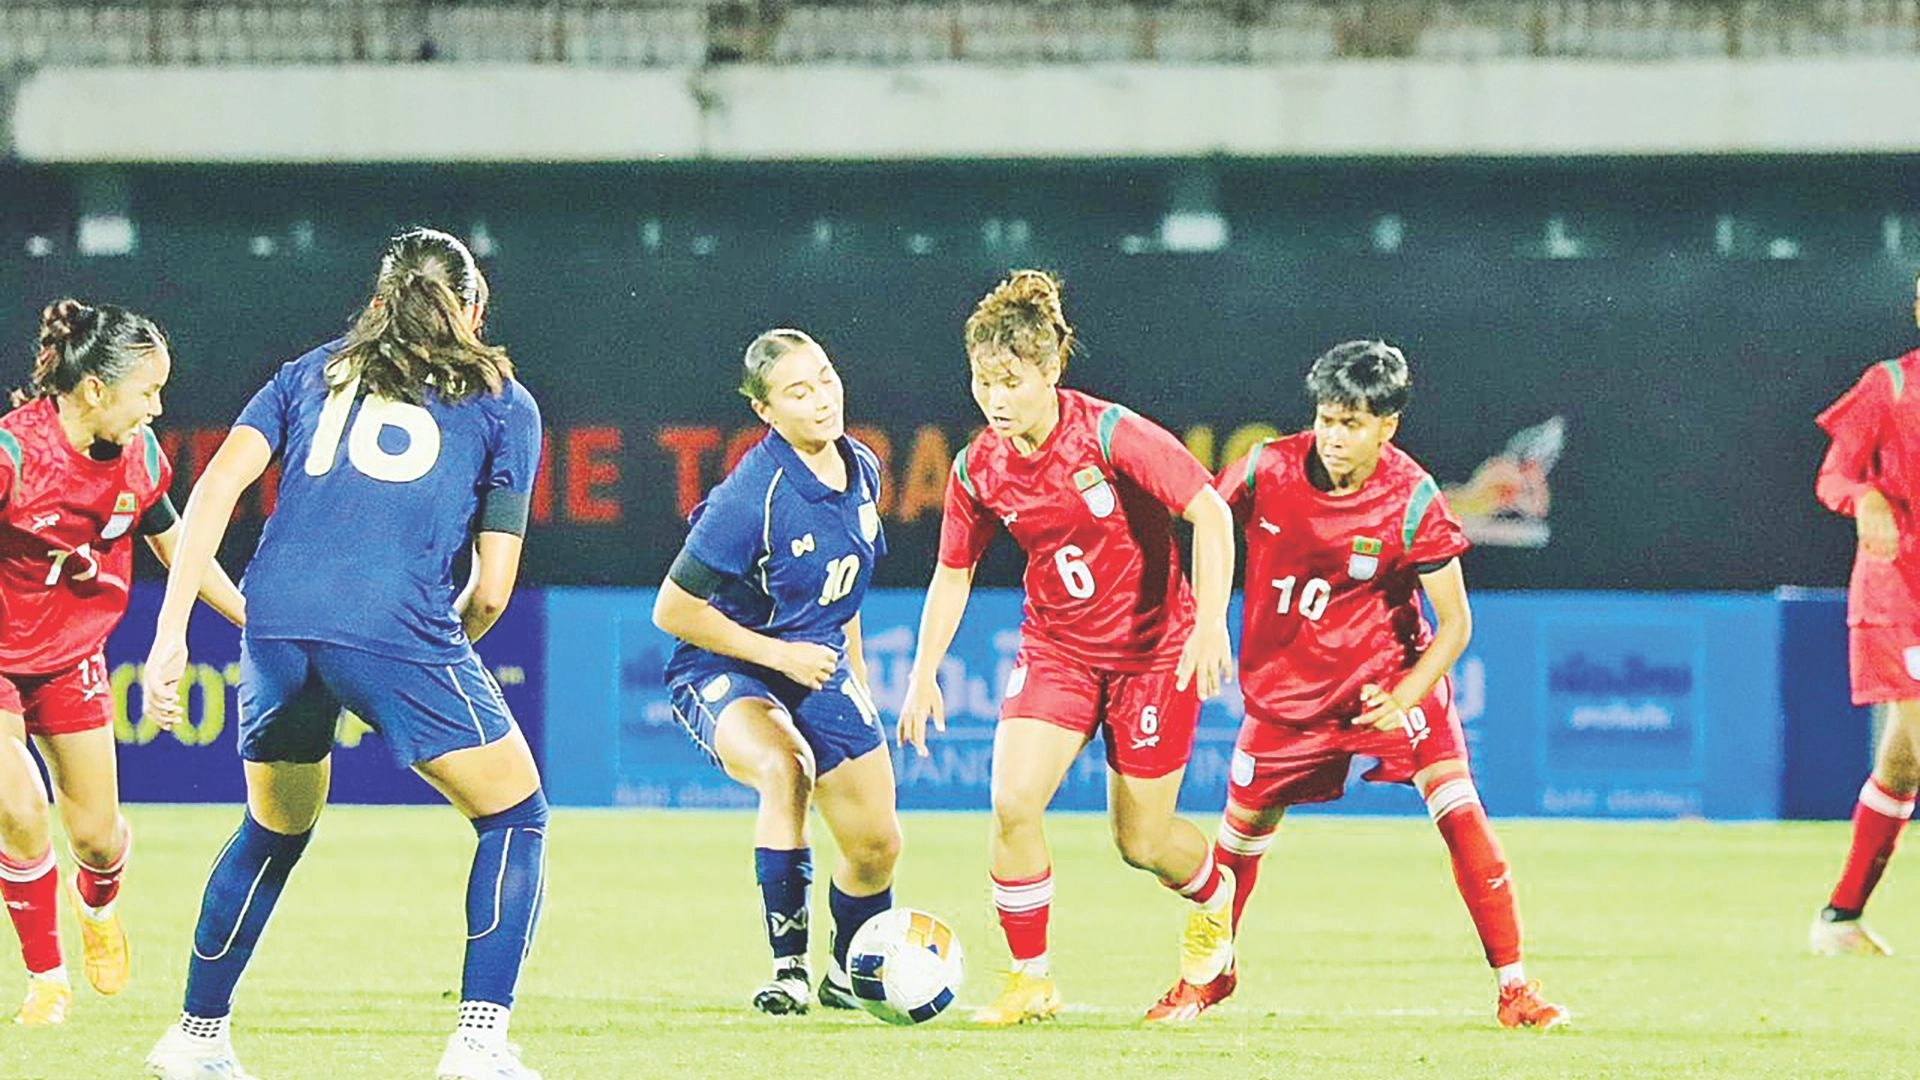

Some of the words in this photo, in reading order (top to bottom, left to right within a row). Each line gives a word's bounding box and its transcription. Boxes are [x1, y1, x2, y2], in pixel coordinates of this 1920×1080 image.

[304, 353, 441, 483] 16
[818, 554, 860, 606] 10
[1054, 544, 1096, 599] 6
[1272, 575, 1331, 621] 10
[1140, 705, 1158, 734] 6
[1401, 707, 1428, 738] 10
